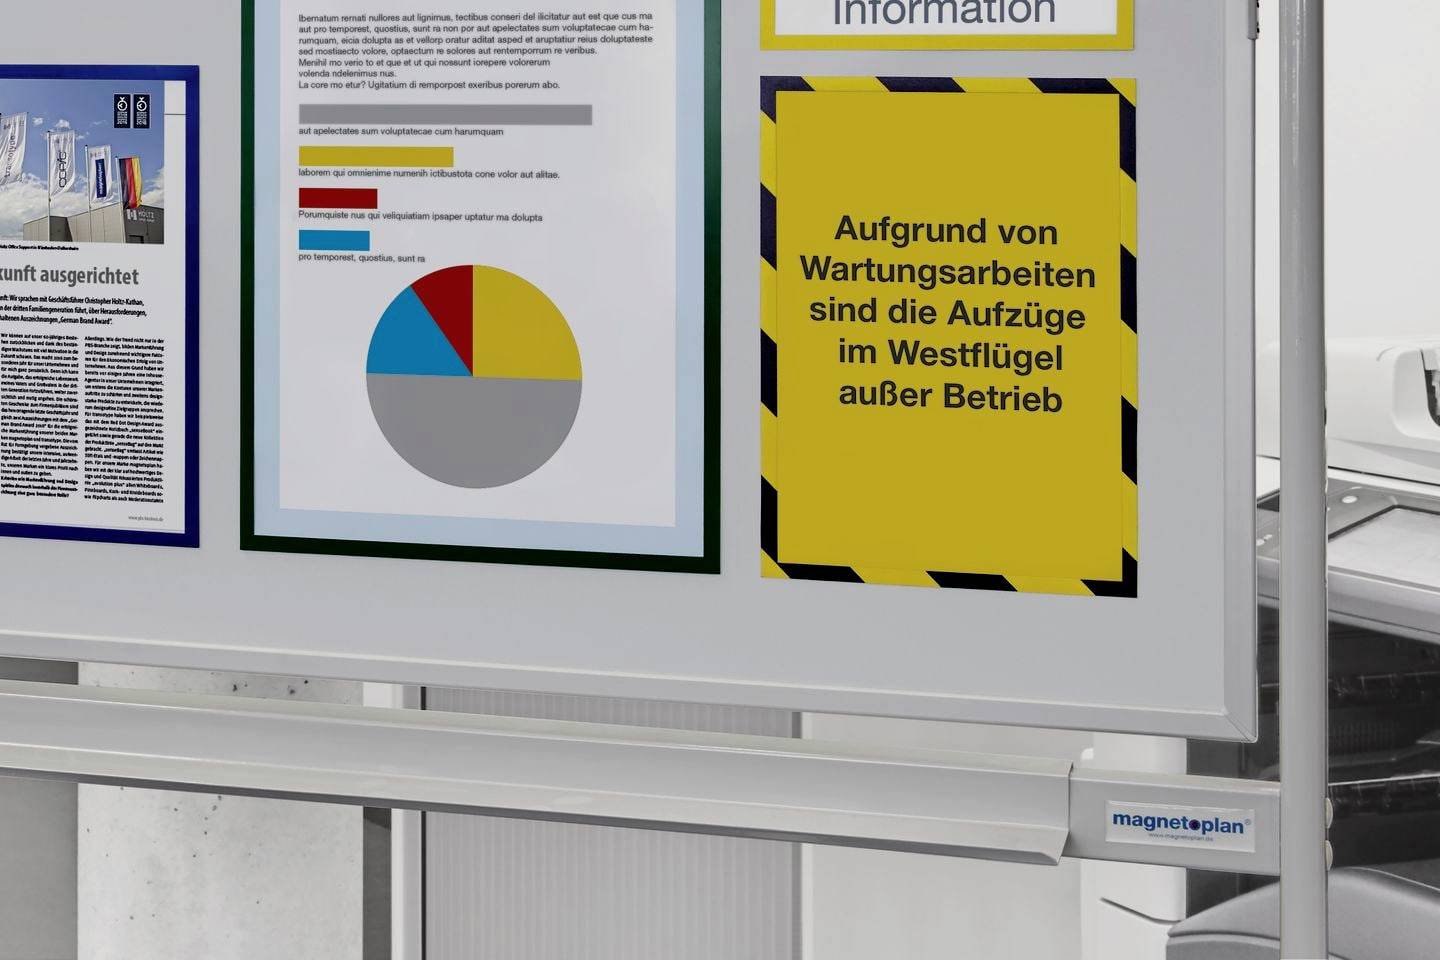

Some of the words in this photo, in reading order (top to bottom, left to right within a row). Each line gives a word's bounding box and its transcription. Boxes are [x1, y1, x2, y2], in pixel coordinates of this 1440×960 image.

[368, 13, 400, 22] nullores
[416, 13, 453, 23] lignimus,
[455, 12, 488, 21] tectibus
[490, 12, 520, 21] conseri
[522, 12, 536, 20] del
[602, 13, 619, 21] que
[373, 24, 410, 34] quostius,
[638, 22, 653, 31] ha-
[298, 80, 309, 88] La
[345, 80, 366, 88] etur?
[367, 80, 407, 90] Ugitatium
[408, 80, 416, 88] di
[504, 82, 540, 90] porerum
[542, 80, 560, 88] abo.
[313, 126, 359, 136] apelectates
[380, 126, 432, 136] voluptatecae
[454, 127, 503, 136] harumquam
[298, 168, 330, 176] laborem
[332, 168, 345, 178] qui
[497, 169, 518, 178] volor
[535, 169, 559, 178] alitae.
[834, 215, 986, 248] Aufgrund
[997, 224, 1057, 244] von
[40, 266, 139, 287] ausgerichtet
[799, 254, 1095, 290] Wartungsarbeiten
[810, 296, 876, 322] sind
[888, 298, 936, 324] die
[947, 299, 1085, 334] Aufzüge
[839, 337, 876, 363] im
[887, 339, 1062, 375] Westflügel
[839, 380, 932, 407] außer
[944, 382, 1062, 412] Betrieb
